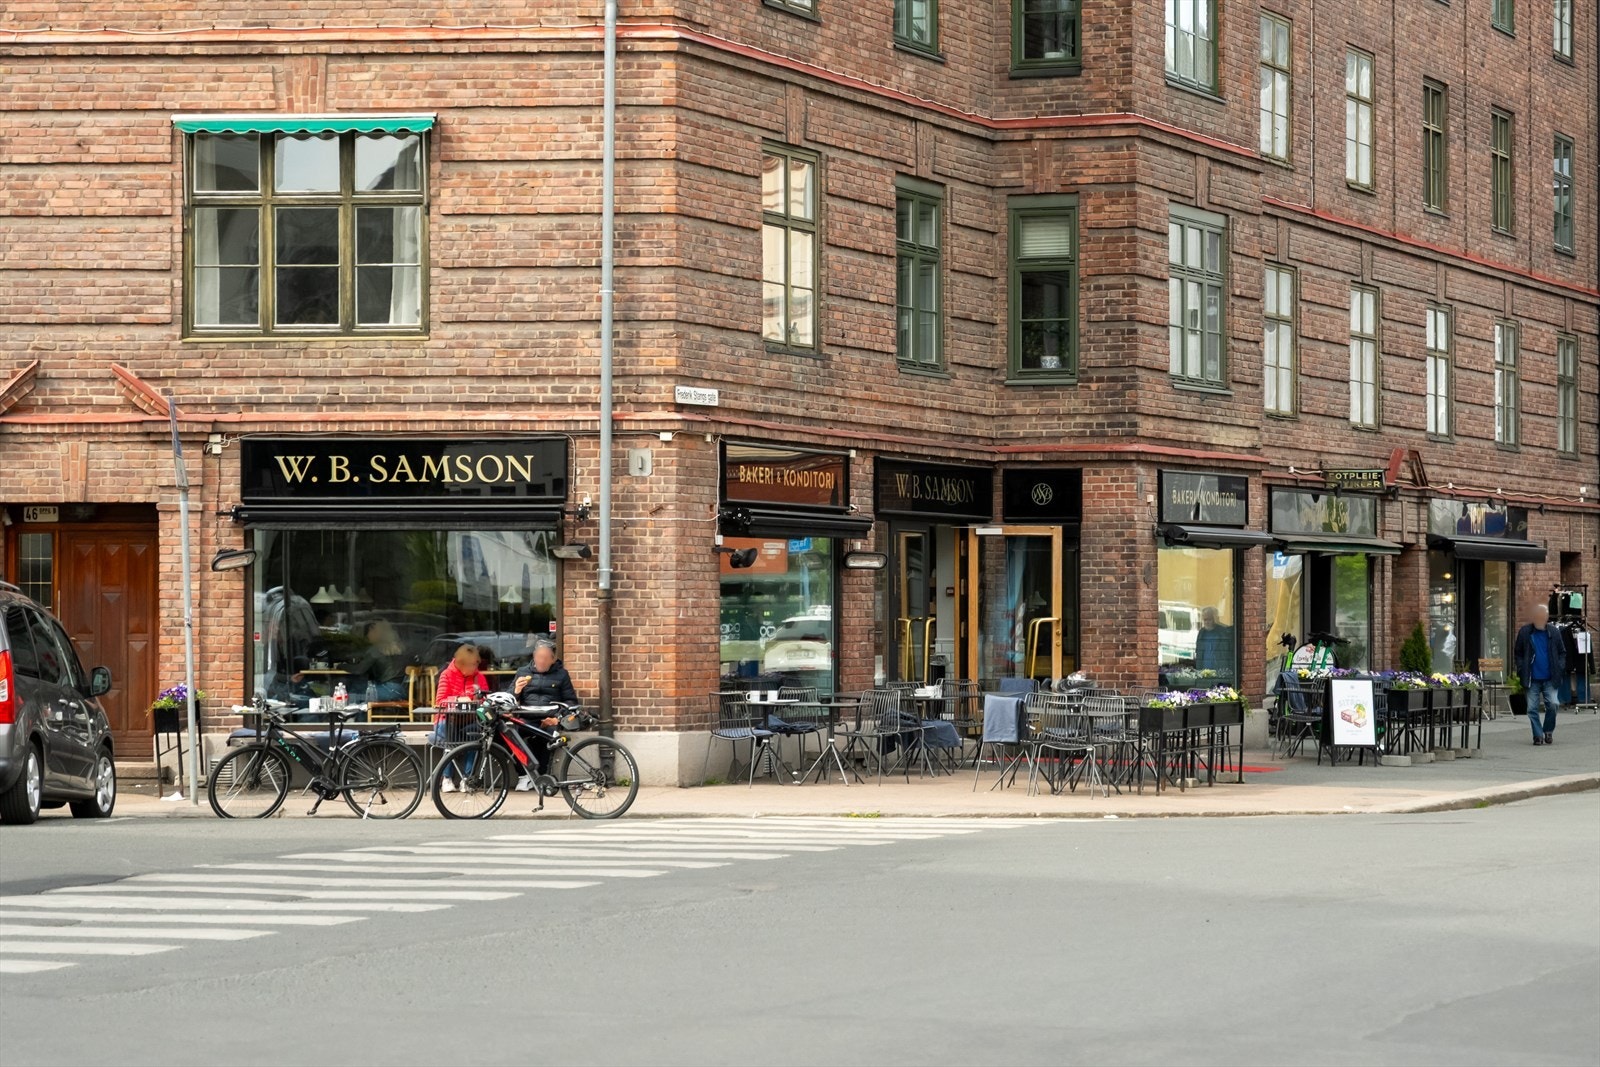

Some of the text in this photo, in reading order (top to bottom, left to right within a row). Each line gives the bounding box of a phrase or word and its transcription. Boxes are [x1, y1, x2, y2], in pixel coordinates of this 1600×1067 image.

[274, 454, 534, 483] W. B. SAMSON
[740, 465, 835, 489] BAKERI & KONDITORI
[896, 473, 975, 503] W. B. SAMSON
[1172, 489, 1237, 507] BAKERI KONDITORI
[25, 507, 38, 520] 46
